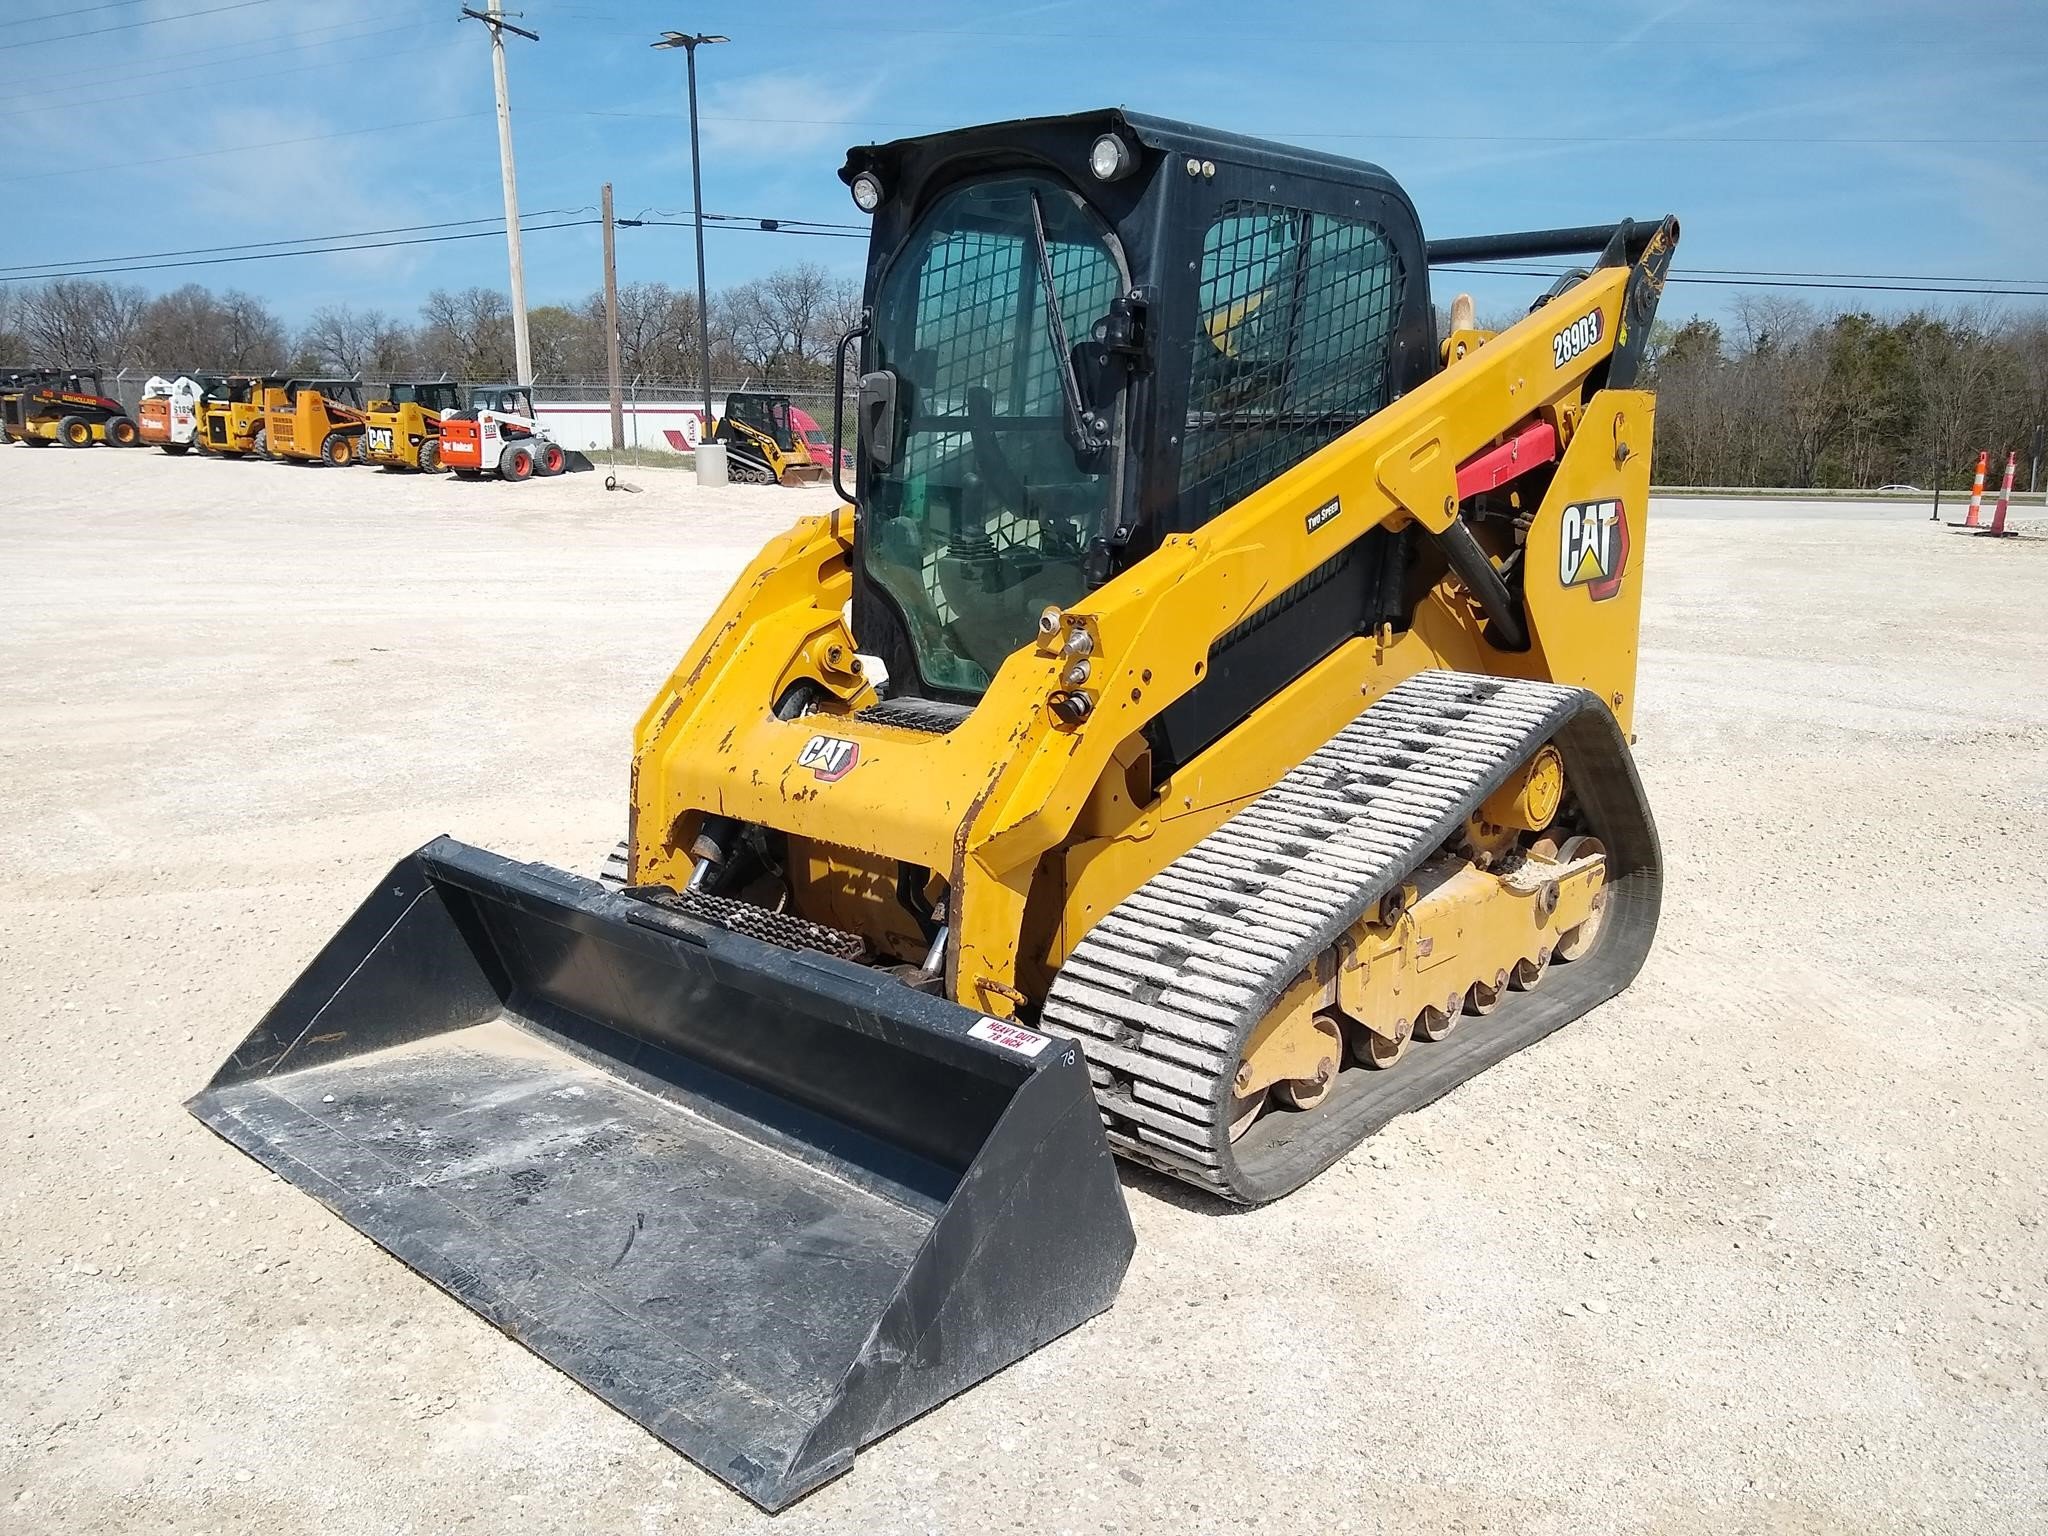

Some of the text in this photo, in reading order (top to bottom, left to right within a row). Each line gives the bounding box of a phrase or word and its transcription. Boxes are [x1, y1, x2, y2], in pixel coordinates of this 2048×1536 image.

[1553, 312, 1598, 369] 289D3
[368, 428, 392, 451] CAT
[1561, 502, 1616, 585] CAT
[799, 736, 854, 773] CAT
[986, 1022, 1041, 1044] HEAVY DUTY
[987, 1032, 1024, 1048] 78 INCH
[1060, 1049, 1076, 1068] 78
